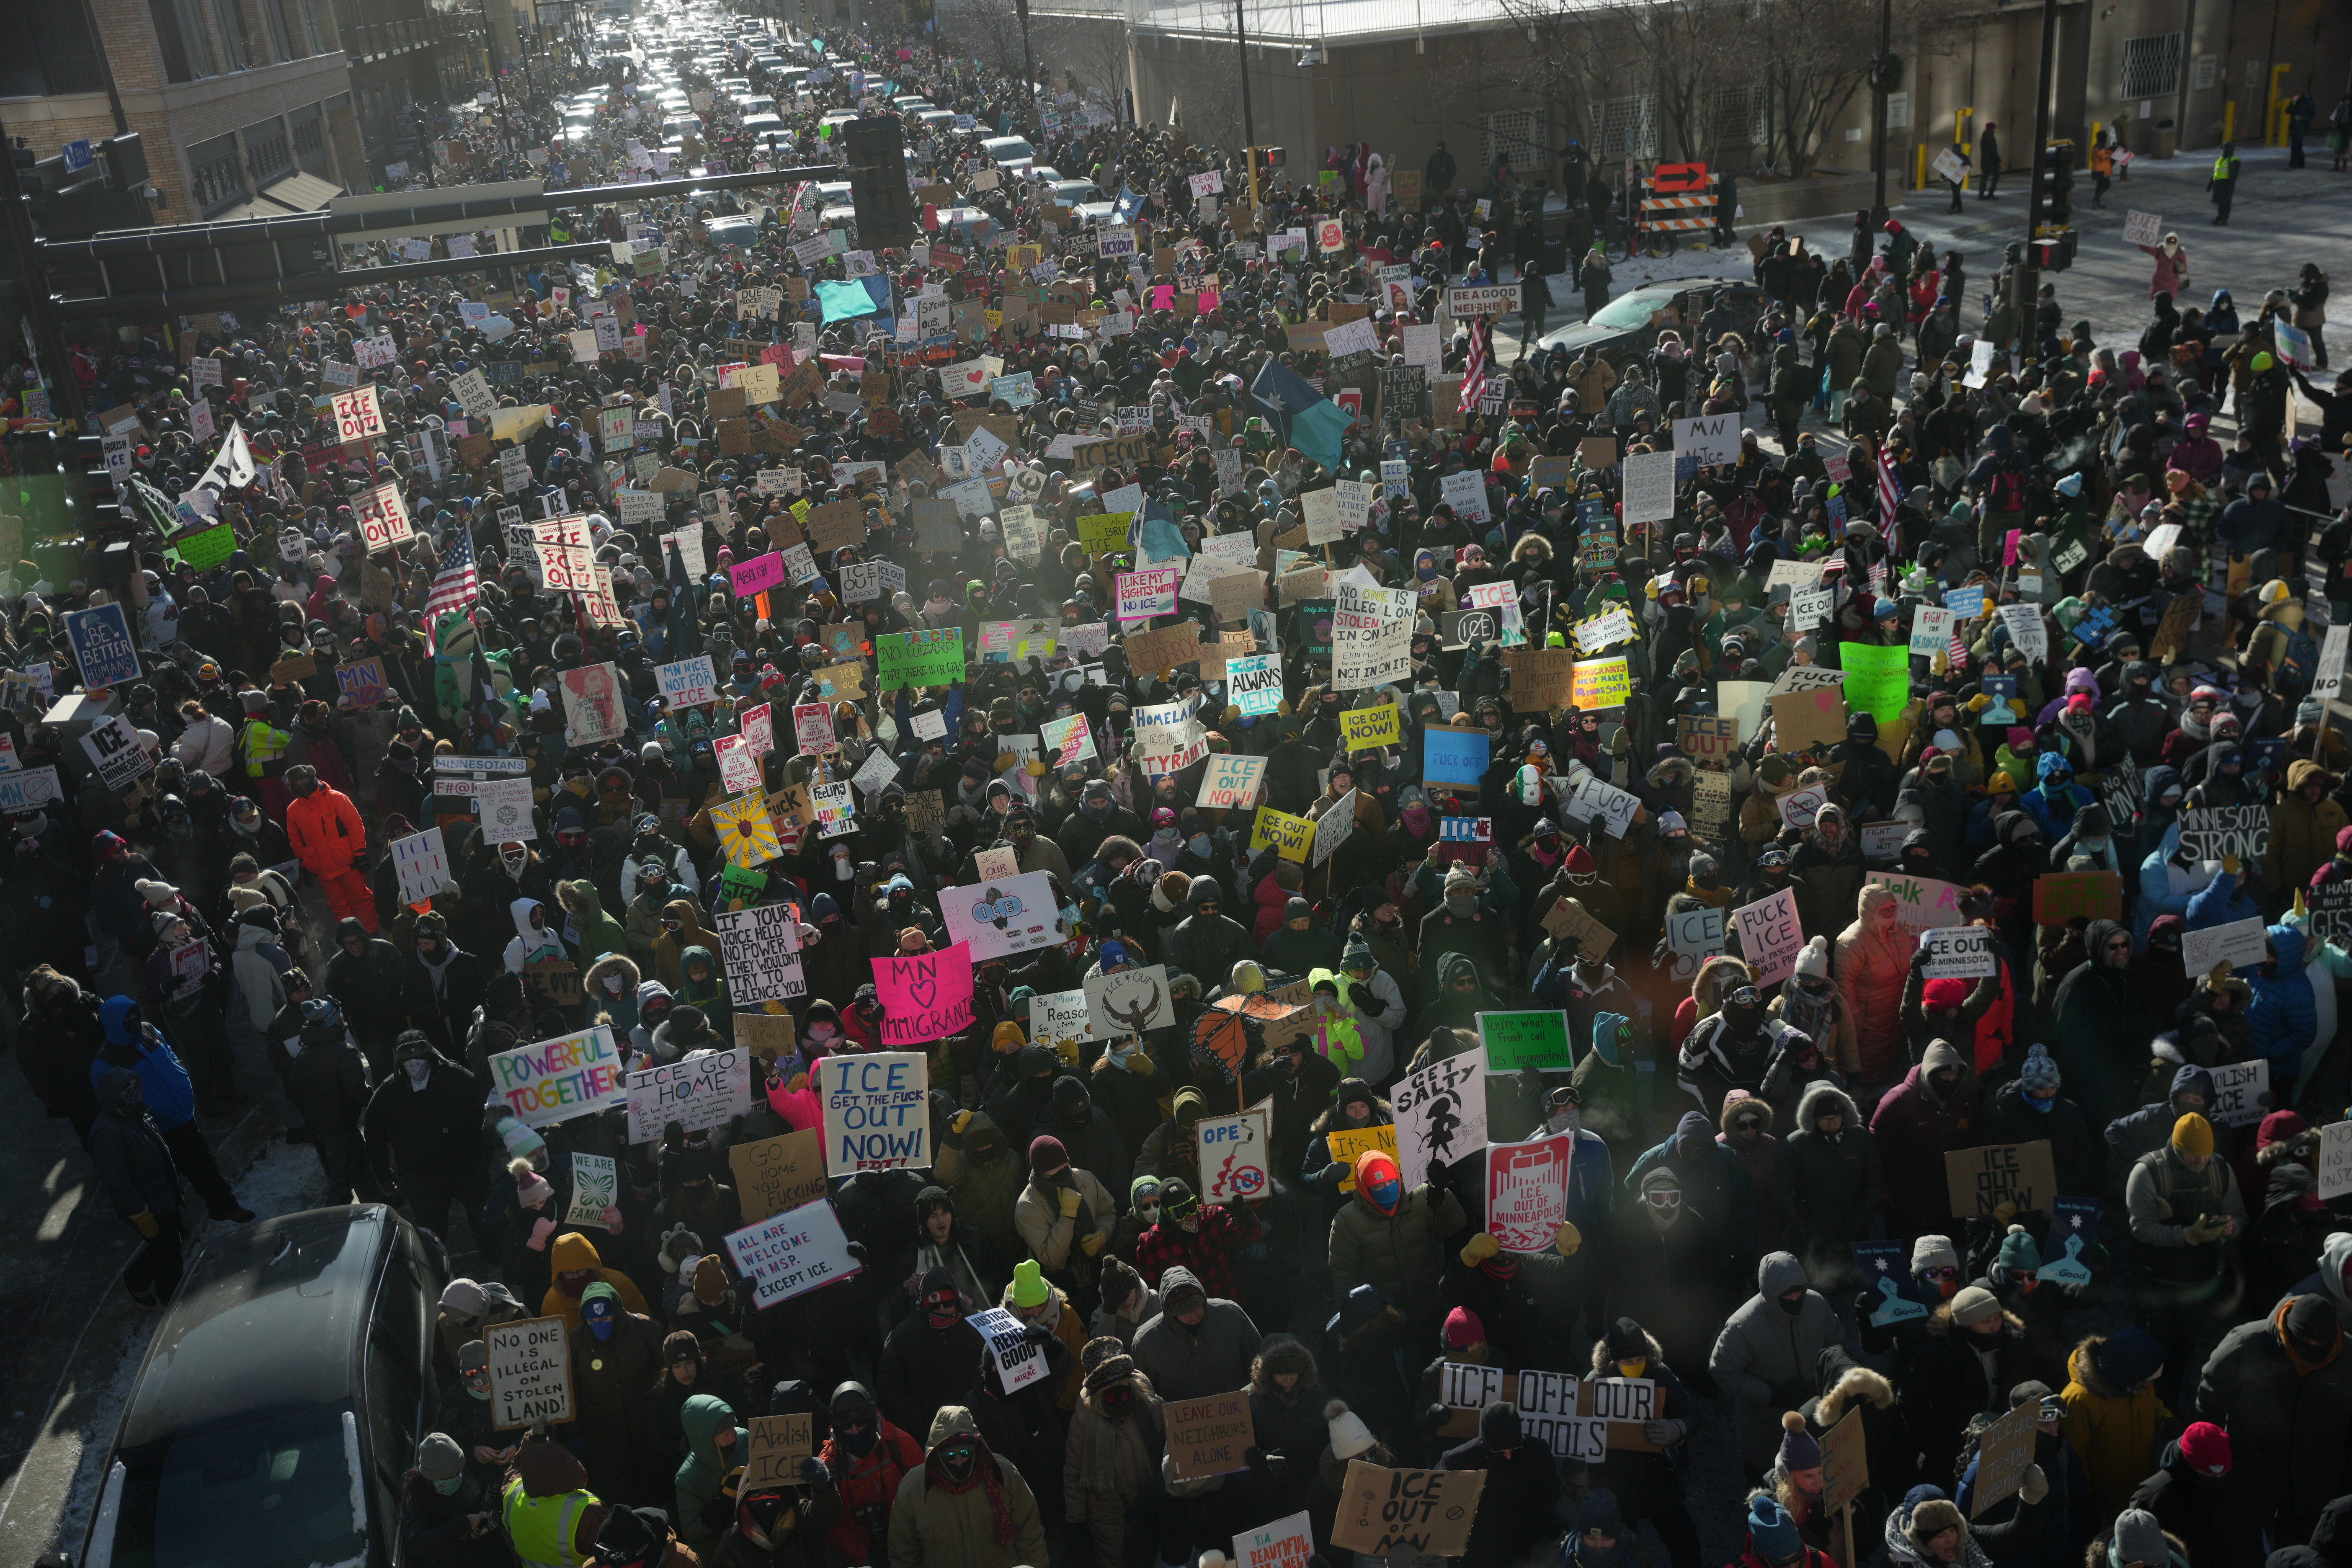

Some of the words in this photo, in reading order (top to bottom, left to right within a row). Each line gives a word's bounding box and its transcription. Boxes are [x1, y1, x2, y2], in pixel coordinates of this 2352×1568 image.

[1191, 172, 1219, 185] ICE-OUT
[1200, 185, 1213, 193] MN
[2127, 212, 2160, 230] RENEE
[2127, 227, 2154, 244] GOOD
[796, 238, 817, 249] OPERATION
[742, 289, 761, 298] DUE
[1454, 291, 1468, 299] BE
[1482, 286, 1516, 298] GOOD
[922, 300, 949, 314] 5-YEAR-
[1454, 300, 1516, 313] NEIGHBR
[923, 317, 939, 328] OLDS,
[1100, 315, 1119, 326] ICE
[1104, 323, 1129, 331] STINKS
[930, 325, 949, 337] DUDE
[1385, 366, 1425, 381] TRUMP:
[456, 374, 476, 389] ICE
[1385, 383, 1421, 395] PLEAD
[461, 384, 479, 398] OUT
[467, 394, 485, 405] FOR
[468, 401, 493, 418] GOOD
[1384, 404, 1416, 419] 25TH!
[1181, 417, 1208, 427] DE-ICE
[1689, 420, 1724, 436] MN
[104, 440, 127, 451] ABOLISH
[107, 453, 125, 467] ICE
[1826, 457, 1847, 469] FASCISM
[110, 466, 126, 477] NOW
[1385, 465, 1402, 475] ICE
[1830, 470, 1851, 481] TREASON
[1385, 485, 1408, 496] MN
[623, 508, 660, 517] TERRORIST
[623, 515, 664, 524] ORGANIZATION
[1120, 576, 1124, 587] I
[1124, 574, 1145, 586] LIKE
[1149, 571, 1165, 583] MY
[1121, 585, 1153, 598] RIGHTS
[1154, 584, 1175, 595] WITH
[1124, 600, 1137, 611] NO
[1140, 598, 1156, 608] ICE
[139, 614, 148, 631] ONE
[1923, 612, 1947, 624] FIGHT
[89, 629, 108, 644] BE
[142, 629, 151, 646] WAY
[1913, 633, 1951, 649] DEMOCRACY
[83, 640, 131, 666] BETTER
[85, 658, 134, 681] HUMANS
[663, 665, 679, 677] MN
[683, 659, 708, 675] NICE
[665, 676, 686, 691] NOT
[689, 672, 711, 686] FOR
[674, 688, 707, 704] ICE
[435, 757, 525, 771] MINNESOTANS
[2179, 806, 2269, 832] MINNESOTA
[399, 840, 436, 862] ICE
[2181, 830, 2267, 861] STRONG
[402, 857, 441, 879] OUT
[405, 873, 450, 901] NOW
[1742, 899, 1788, 936] FUCK
[1754, 922, 1794, 953] ICE
[1204, 1124, 1239, 1143] OPE
[575, 1155, 590, 1167] WE
[594, 1157, 614, 1170] ARE
[1983, 1148, 2019, 1170] ICE
[1976, 1168, 2021, 1191] OUT
[1520, 1185, 1545, 1200] I.C.E.
[1514, 1198, 1534, 1212] OUT
[1538, 1195, 1549, 1207] OF
[1496, 1203, 1561, 1223] MINNEAPOLIS
[494, 1335, 520, 1350] NO
[528, 1328, 559, 1345] ONE
[520, 1348, 539, 1357] IS
[498, 1358, 559, 1380] ILLEGAL
[520, 1375, 540, 1384] ON
[504, 1383, 562, 1402] STOLEN
[507, 1395, 566, 1421] LAND!
[1175, 1405, 1213, 1423] LEAVE
[1219, 1400, 1242, 1415] OUR
[1173, 1421, 1247, 1445] NEIGHBORS
[1193, 1446, 1232, 1465] ALONE
